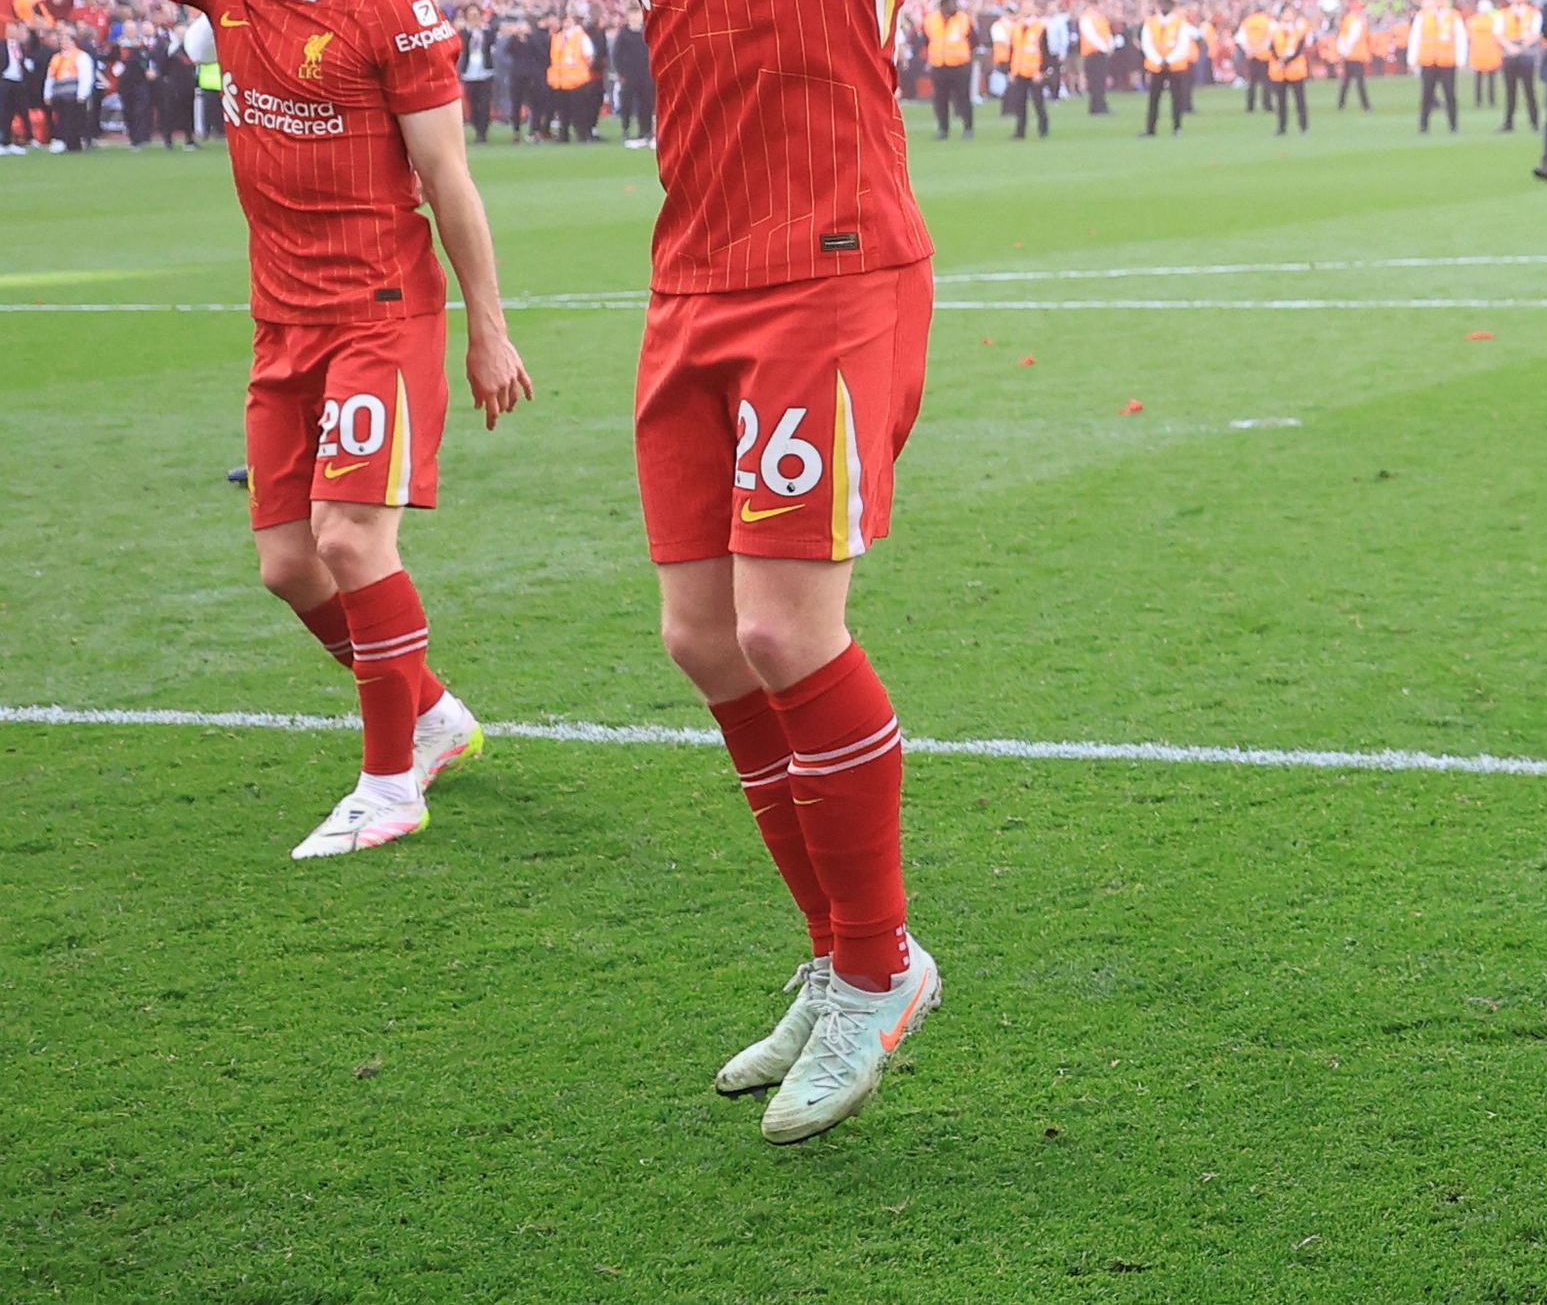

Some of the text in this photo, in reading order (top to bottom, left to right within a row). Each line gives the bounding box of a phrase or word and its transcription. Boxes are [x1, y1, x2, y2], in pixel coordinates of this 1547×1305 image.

[396, 20, 456, 52] Expedi
[244, 88, 334, 117] standard
[245, 108, 344, 135] chartered
[316, 394, 386, 457] 20
[736, 399, 822, 496] 26
